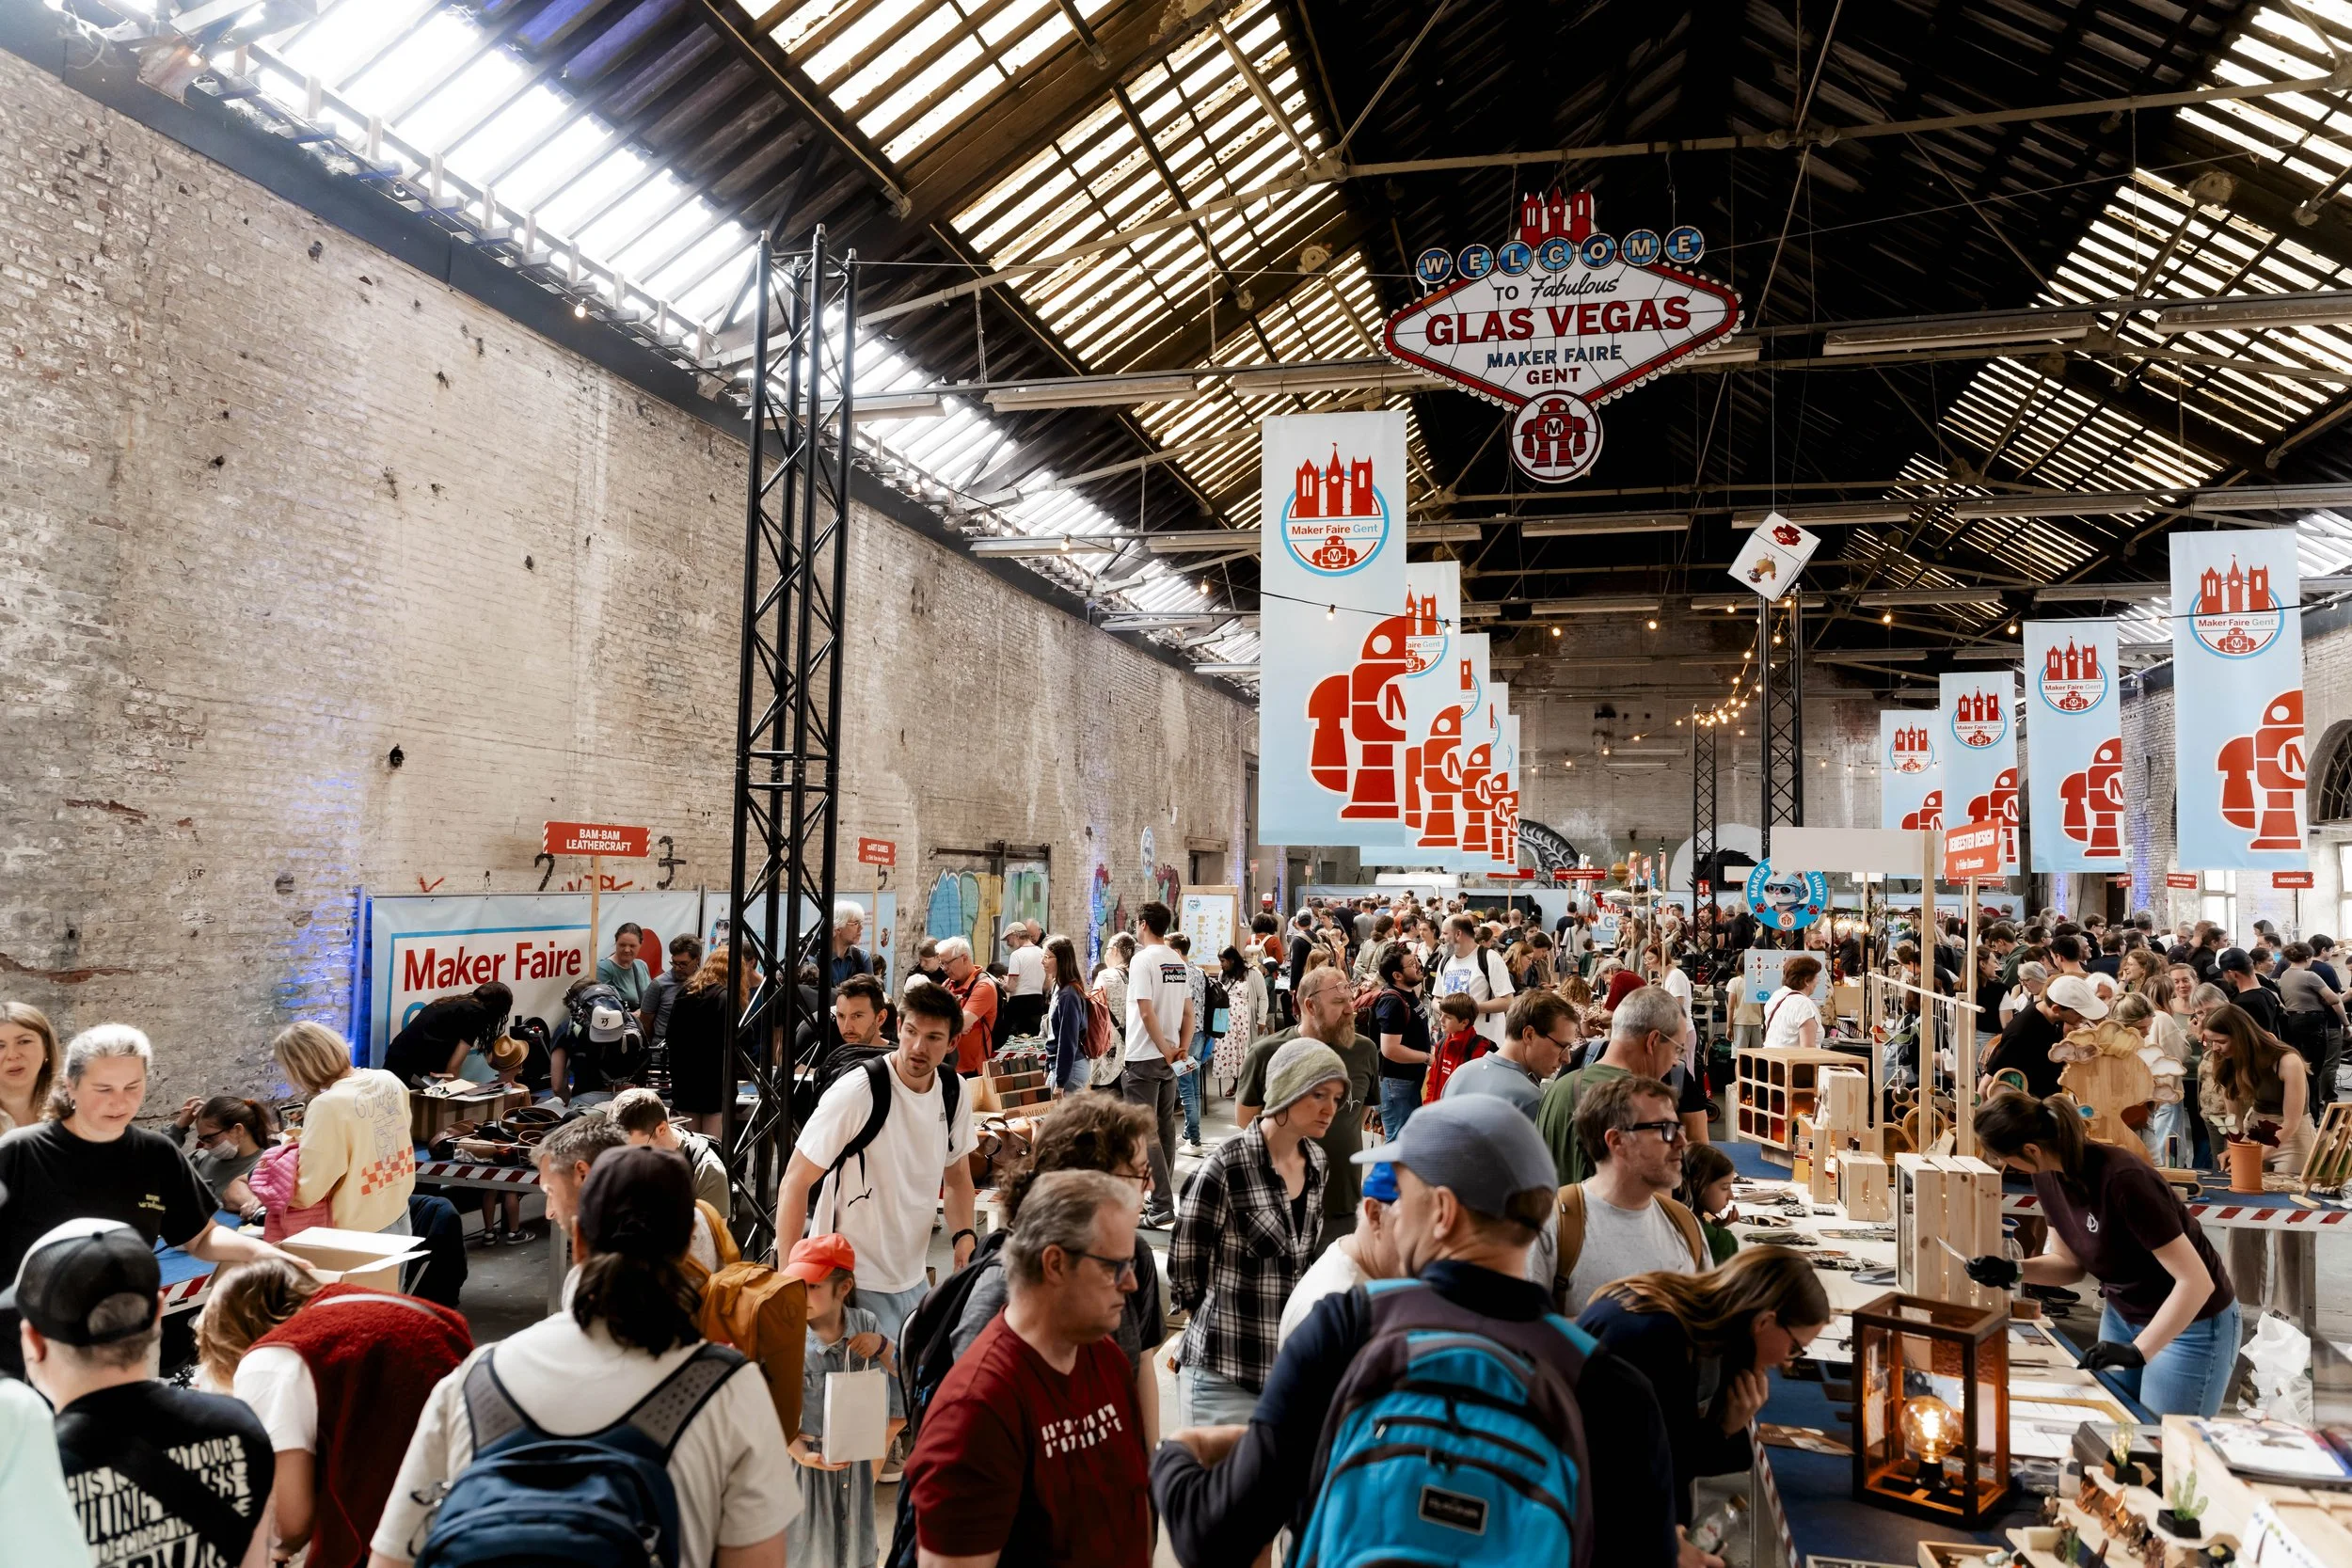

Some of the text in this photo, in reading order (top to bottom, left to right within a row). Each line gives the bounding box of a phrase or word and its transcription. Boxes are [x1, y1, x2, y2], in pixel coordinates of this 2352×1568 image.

[1423, 235, 1692, 274] WELCOME
[1493, 275, 1620, 301] TO Fabulous
[1425, 296, 1692, 346] GLAS VEGAS
[1487, 345, 1622, 369] MAKER FAIRE
[1526, 368, 1581, 385] GENT
[1547, 420, 1562, 436] M
[1292, 524, 1378, 535] Maker Faire Gent
[1329, 550, 1340, 560] M
[2199, 619, 2228, 627] Maker
[2251, 618, 2275, 626] Gent
[566, 839, 632, 851] LEATHERCRAFT
[580, 829, 620, 841] BAM-BAM
[1751, 867, 1768, 898] MAKER
[1811, 875, 1824, 901] HUNT
[404, 941, 581, 991] Maker Faire
